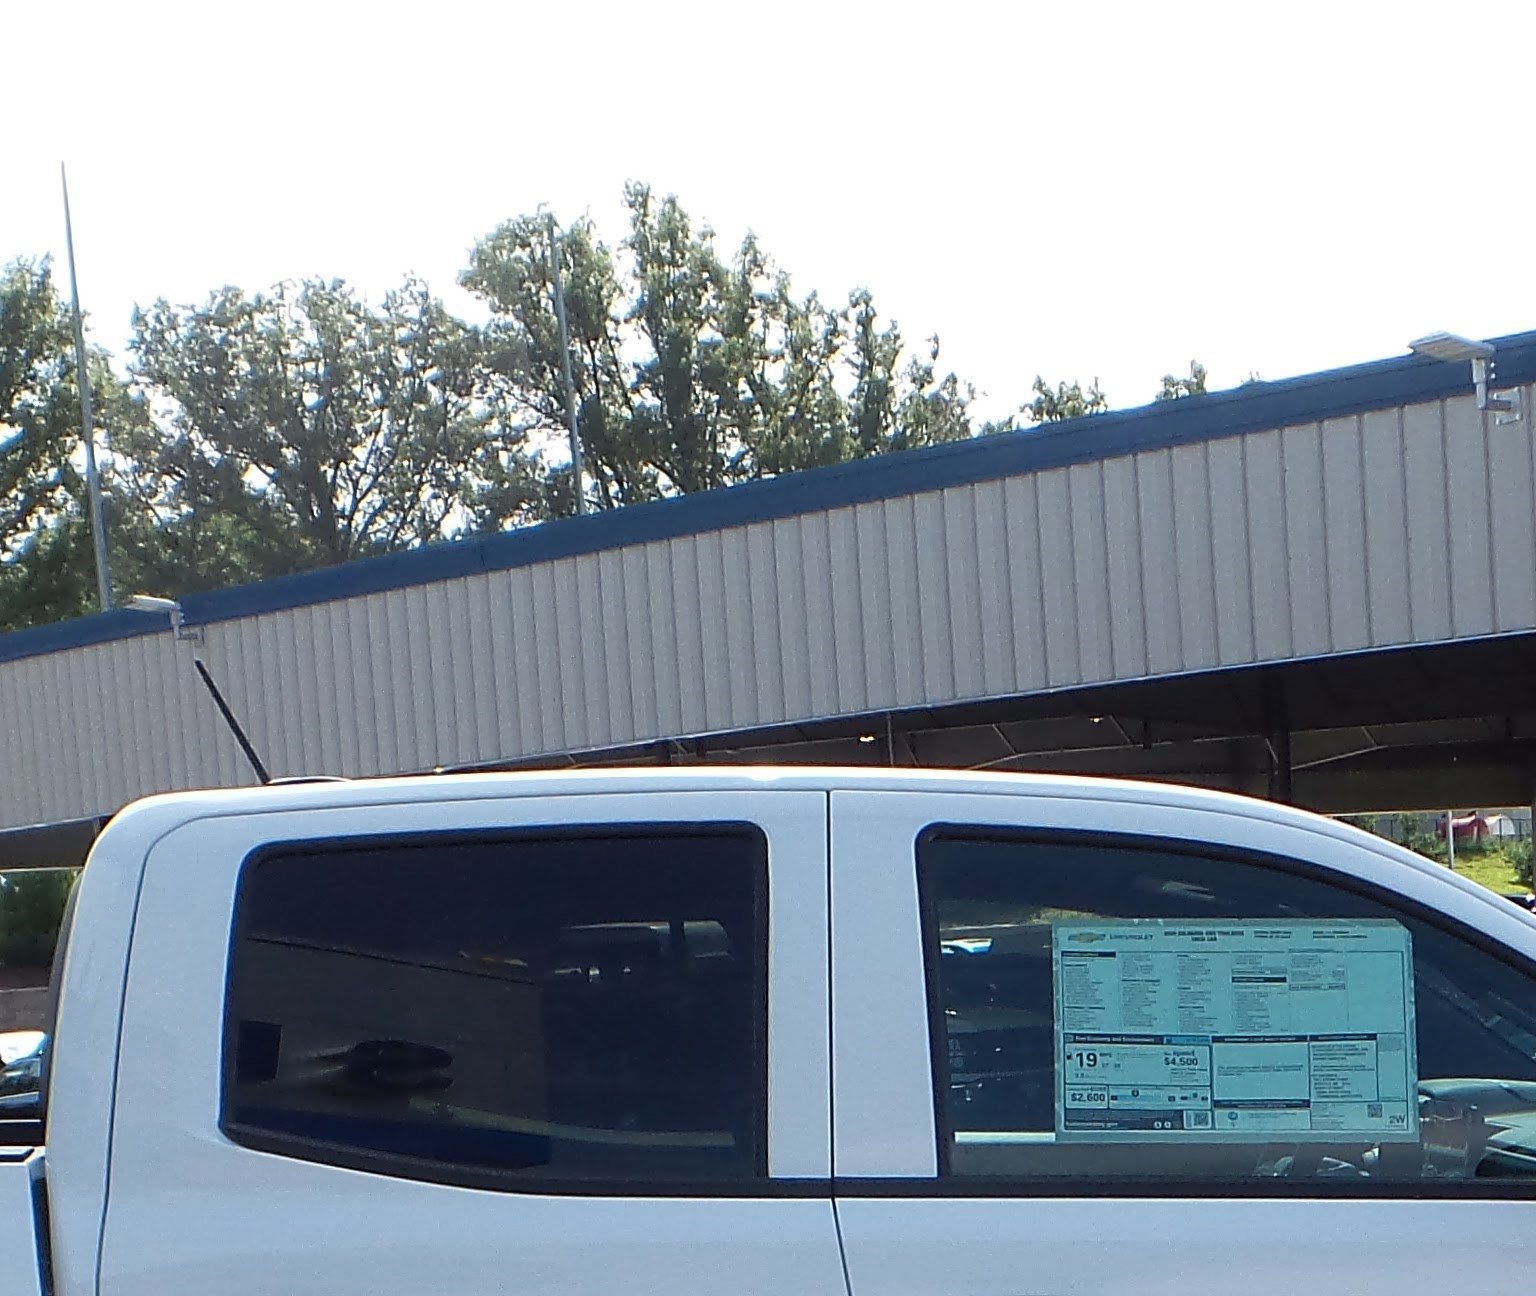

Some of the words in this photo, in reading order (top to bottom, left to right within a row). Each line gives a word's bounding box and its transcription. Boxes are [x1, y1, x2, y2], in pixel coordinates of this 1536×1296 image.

[1075, 1052, 1098, 1068] 19
[1163, 1056, 1199, 1067] $4,500
[1071, 1093, 1106, 1102] $2,600
